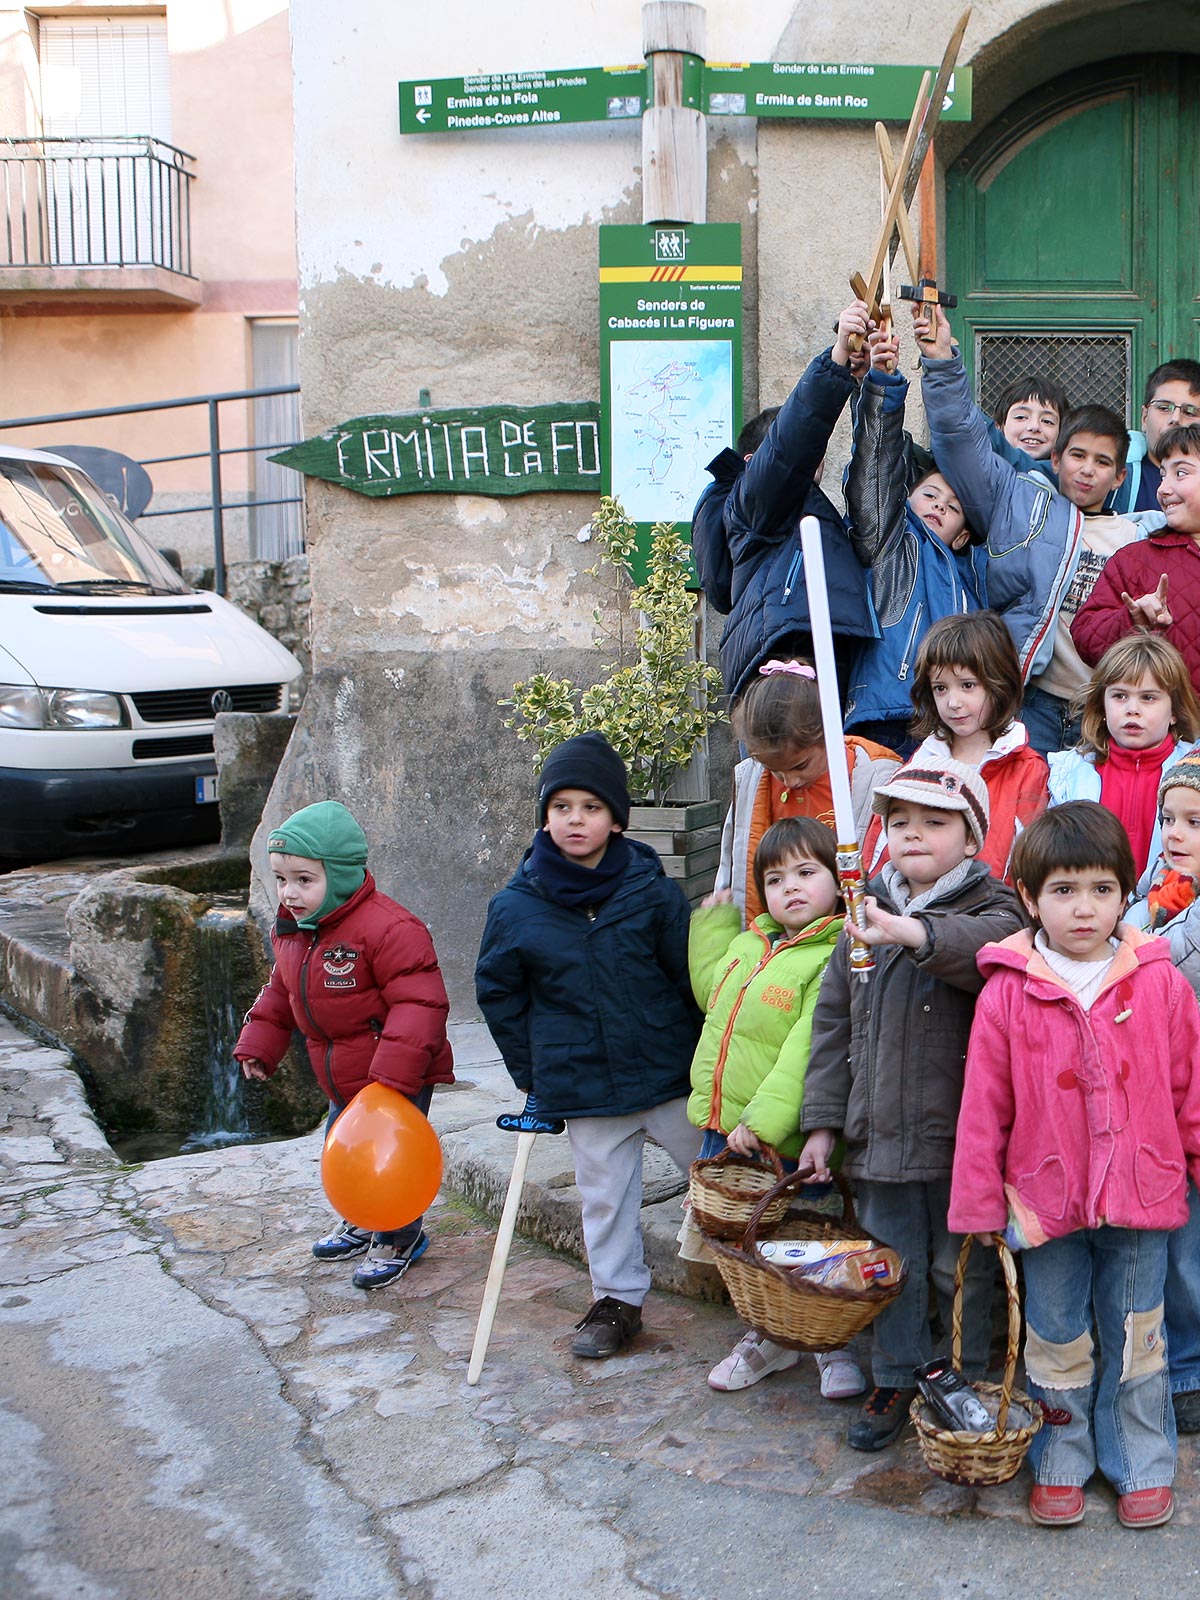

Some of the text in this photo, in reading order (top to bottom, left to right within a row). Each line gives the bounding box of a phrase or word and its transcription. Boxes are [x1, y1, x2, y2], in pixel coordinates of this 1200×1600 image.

[773, 63, 875, 76] Sender de Les Ermites
[464, 84, 490, 93] Sender
[491, 83, 501, 92] de
[503, 82, 510, 91] la
[533, 80, 543, 89] de
[556, 77, 587, 87] Pinedes
[447, 94, 483, 109] Ermita
[485, 94, 499, 107] de
[501, 93, 512, 106] la
[755, 93, 869, 108] Ermita de Sant Roc
[447, 109, 560, 127] Pinedes-Coves Altes
[637, 299, 706, 311] Senders de
[608, 315, 661, 329] Cabacés
[670, 316, 686, 328] La
[687, 316, 736, 331] Figuera
[501, 420, 538, 447] DE
[337, 417, 490, 480] ERMITA
[504, 451, 543, 477] LA
[767, 985, 794, 999] cool
[761, 993, 792, 1012] babe
